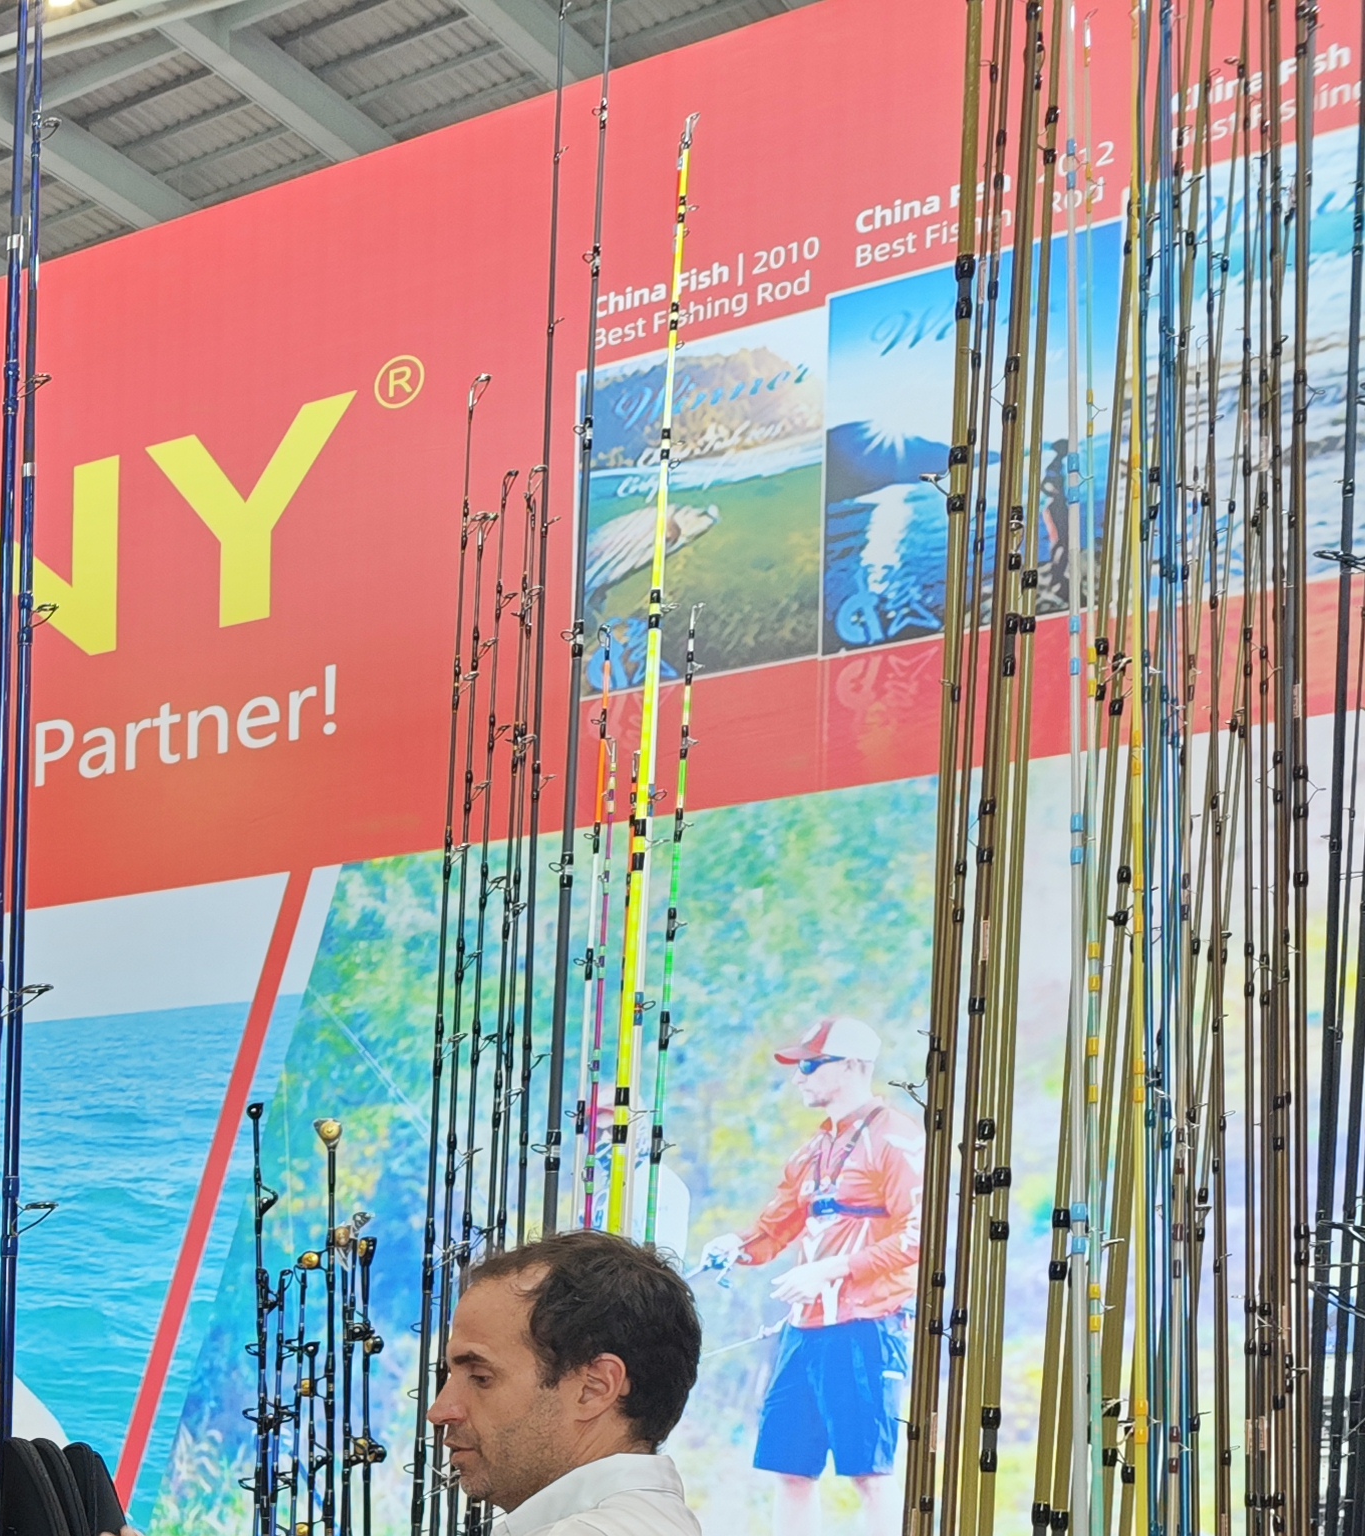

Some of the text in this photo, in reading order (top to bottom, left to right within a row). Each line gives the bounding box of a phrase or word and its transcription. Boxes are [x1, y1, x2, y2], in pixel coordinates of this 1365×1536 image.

[855, 194, 940, 233] China
[855, 231, 917, 268] Best
[594, 318, 646, 350] Best
[757, 270, 811, 306] Rod
[596, 281, 667, 318] China
[678, 262, 730, 295] Fish
[752, 236, 820, 274] 2010
[32, 664, 340, 790] Partner!
